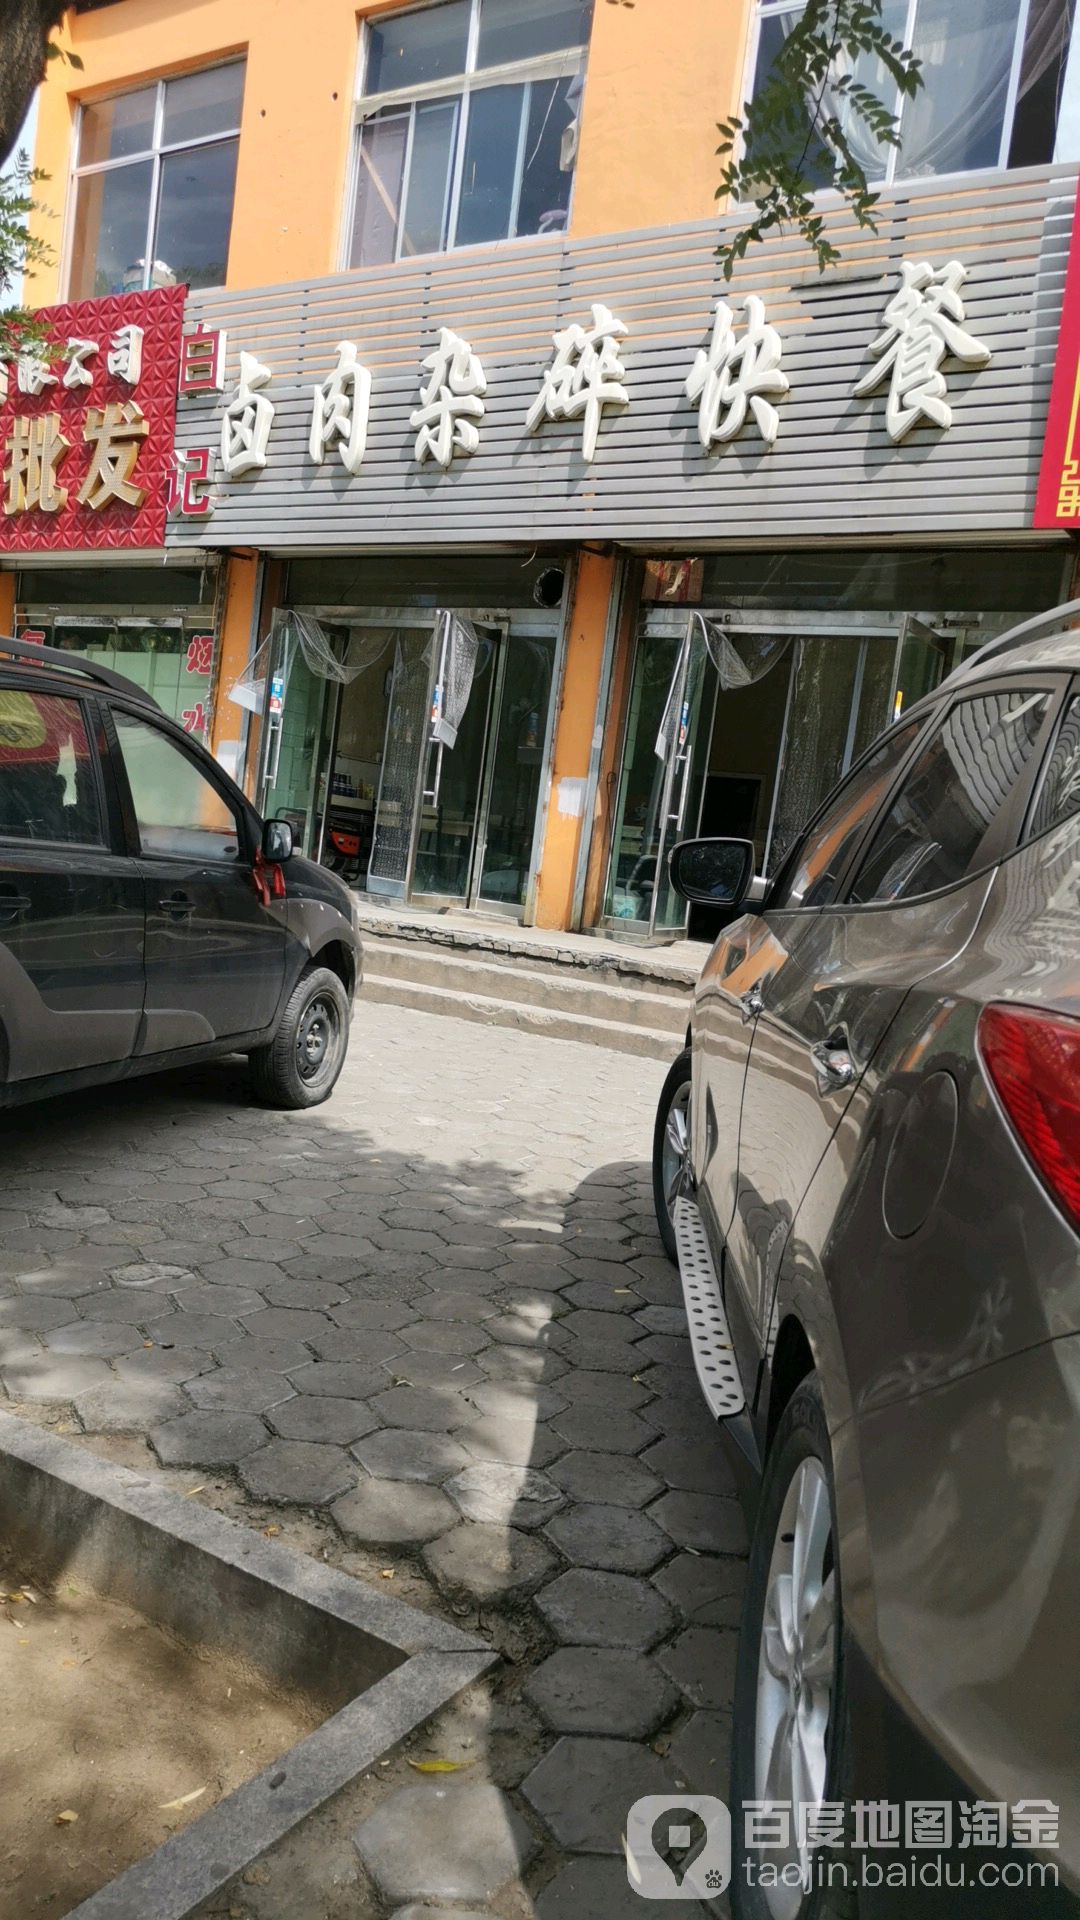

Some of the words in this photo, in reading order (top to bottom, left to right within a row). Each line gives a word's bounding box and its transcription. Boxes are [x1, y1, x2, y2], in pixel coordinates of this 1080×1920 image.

[220, 260, 992, 475] 卤肉杂碎快餐
[3, 400, 149, 516] 批发
